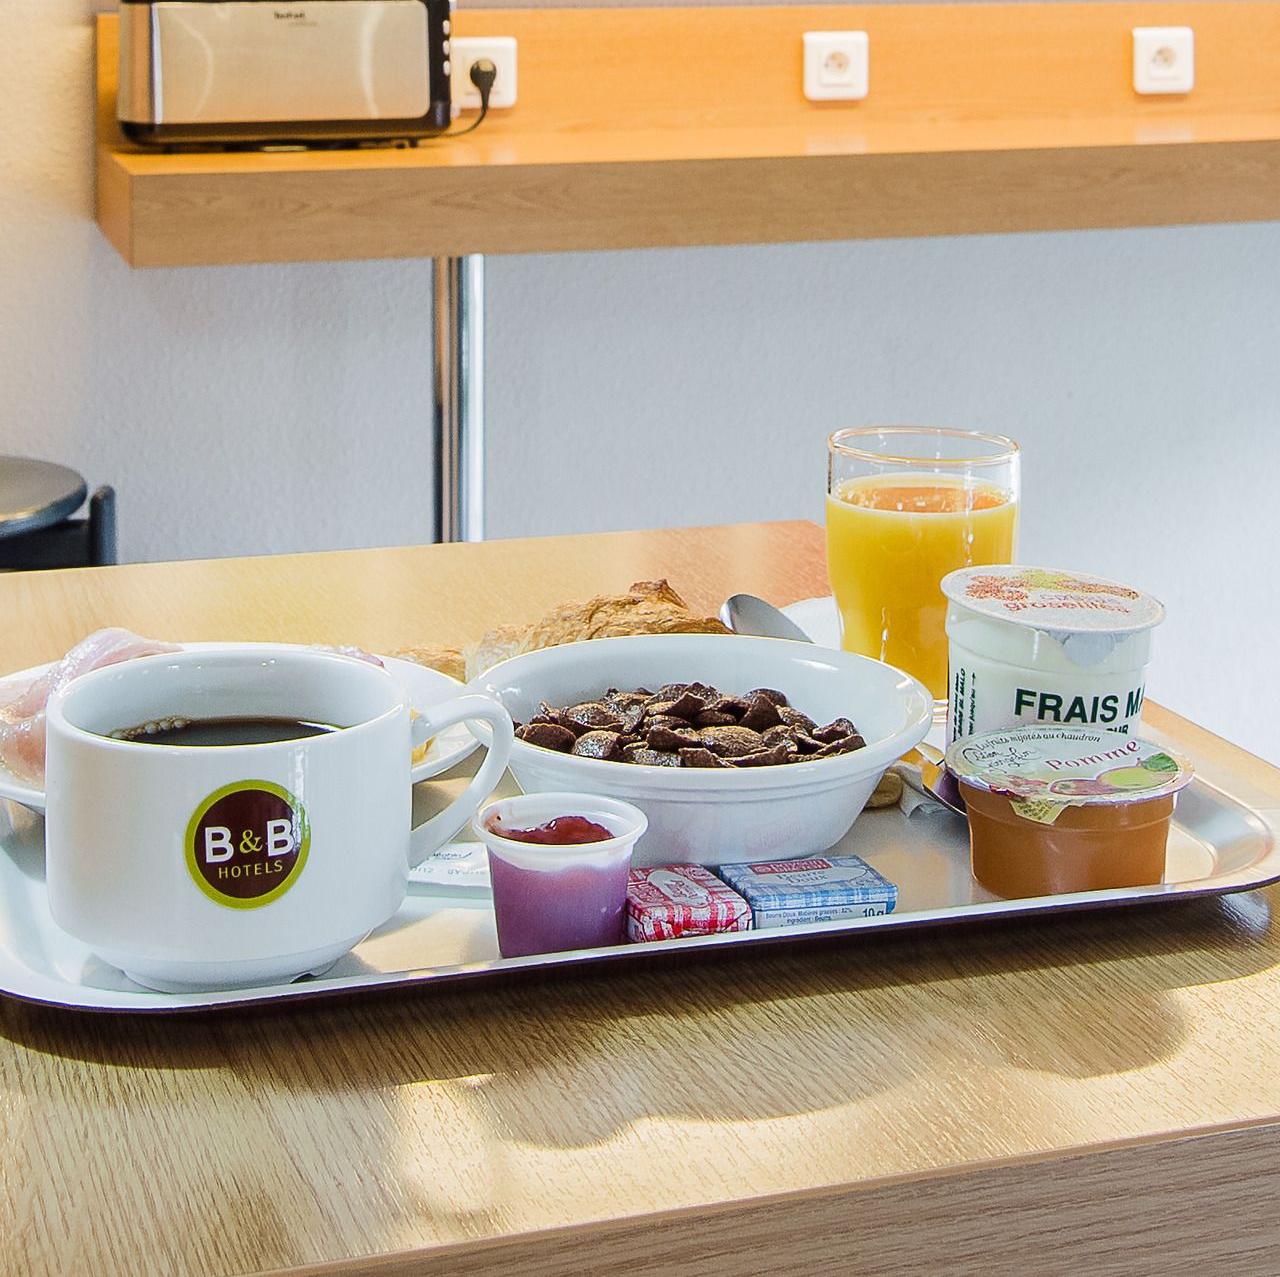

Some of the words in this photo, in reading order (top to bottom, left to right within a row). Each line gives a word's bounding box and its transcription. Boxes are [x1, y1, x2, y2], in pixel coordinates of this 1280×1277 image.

[1014, 688, 1119, 724] FRAIS
[1056, 731, 1101, 743] chaudron
[1045, 740, 1141, 771] Pomme
[218, 860, 284, 879] HOTELS
[863, 907, 875, 917] 10
